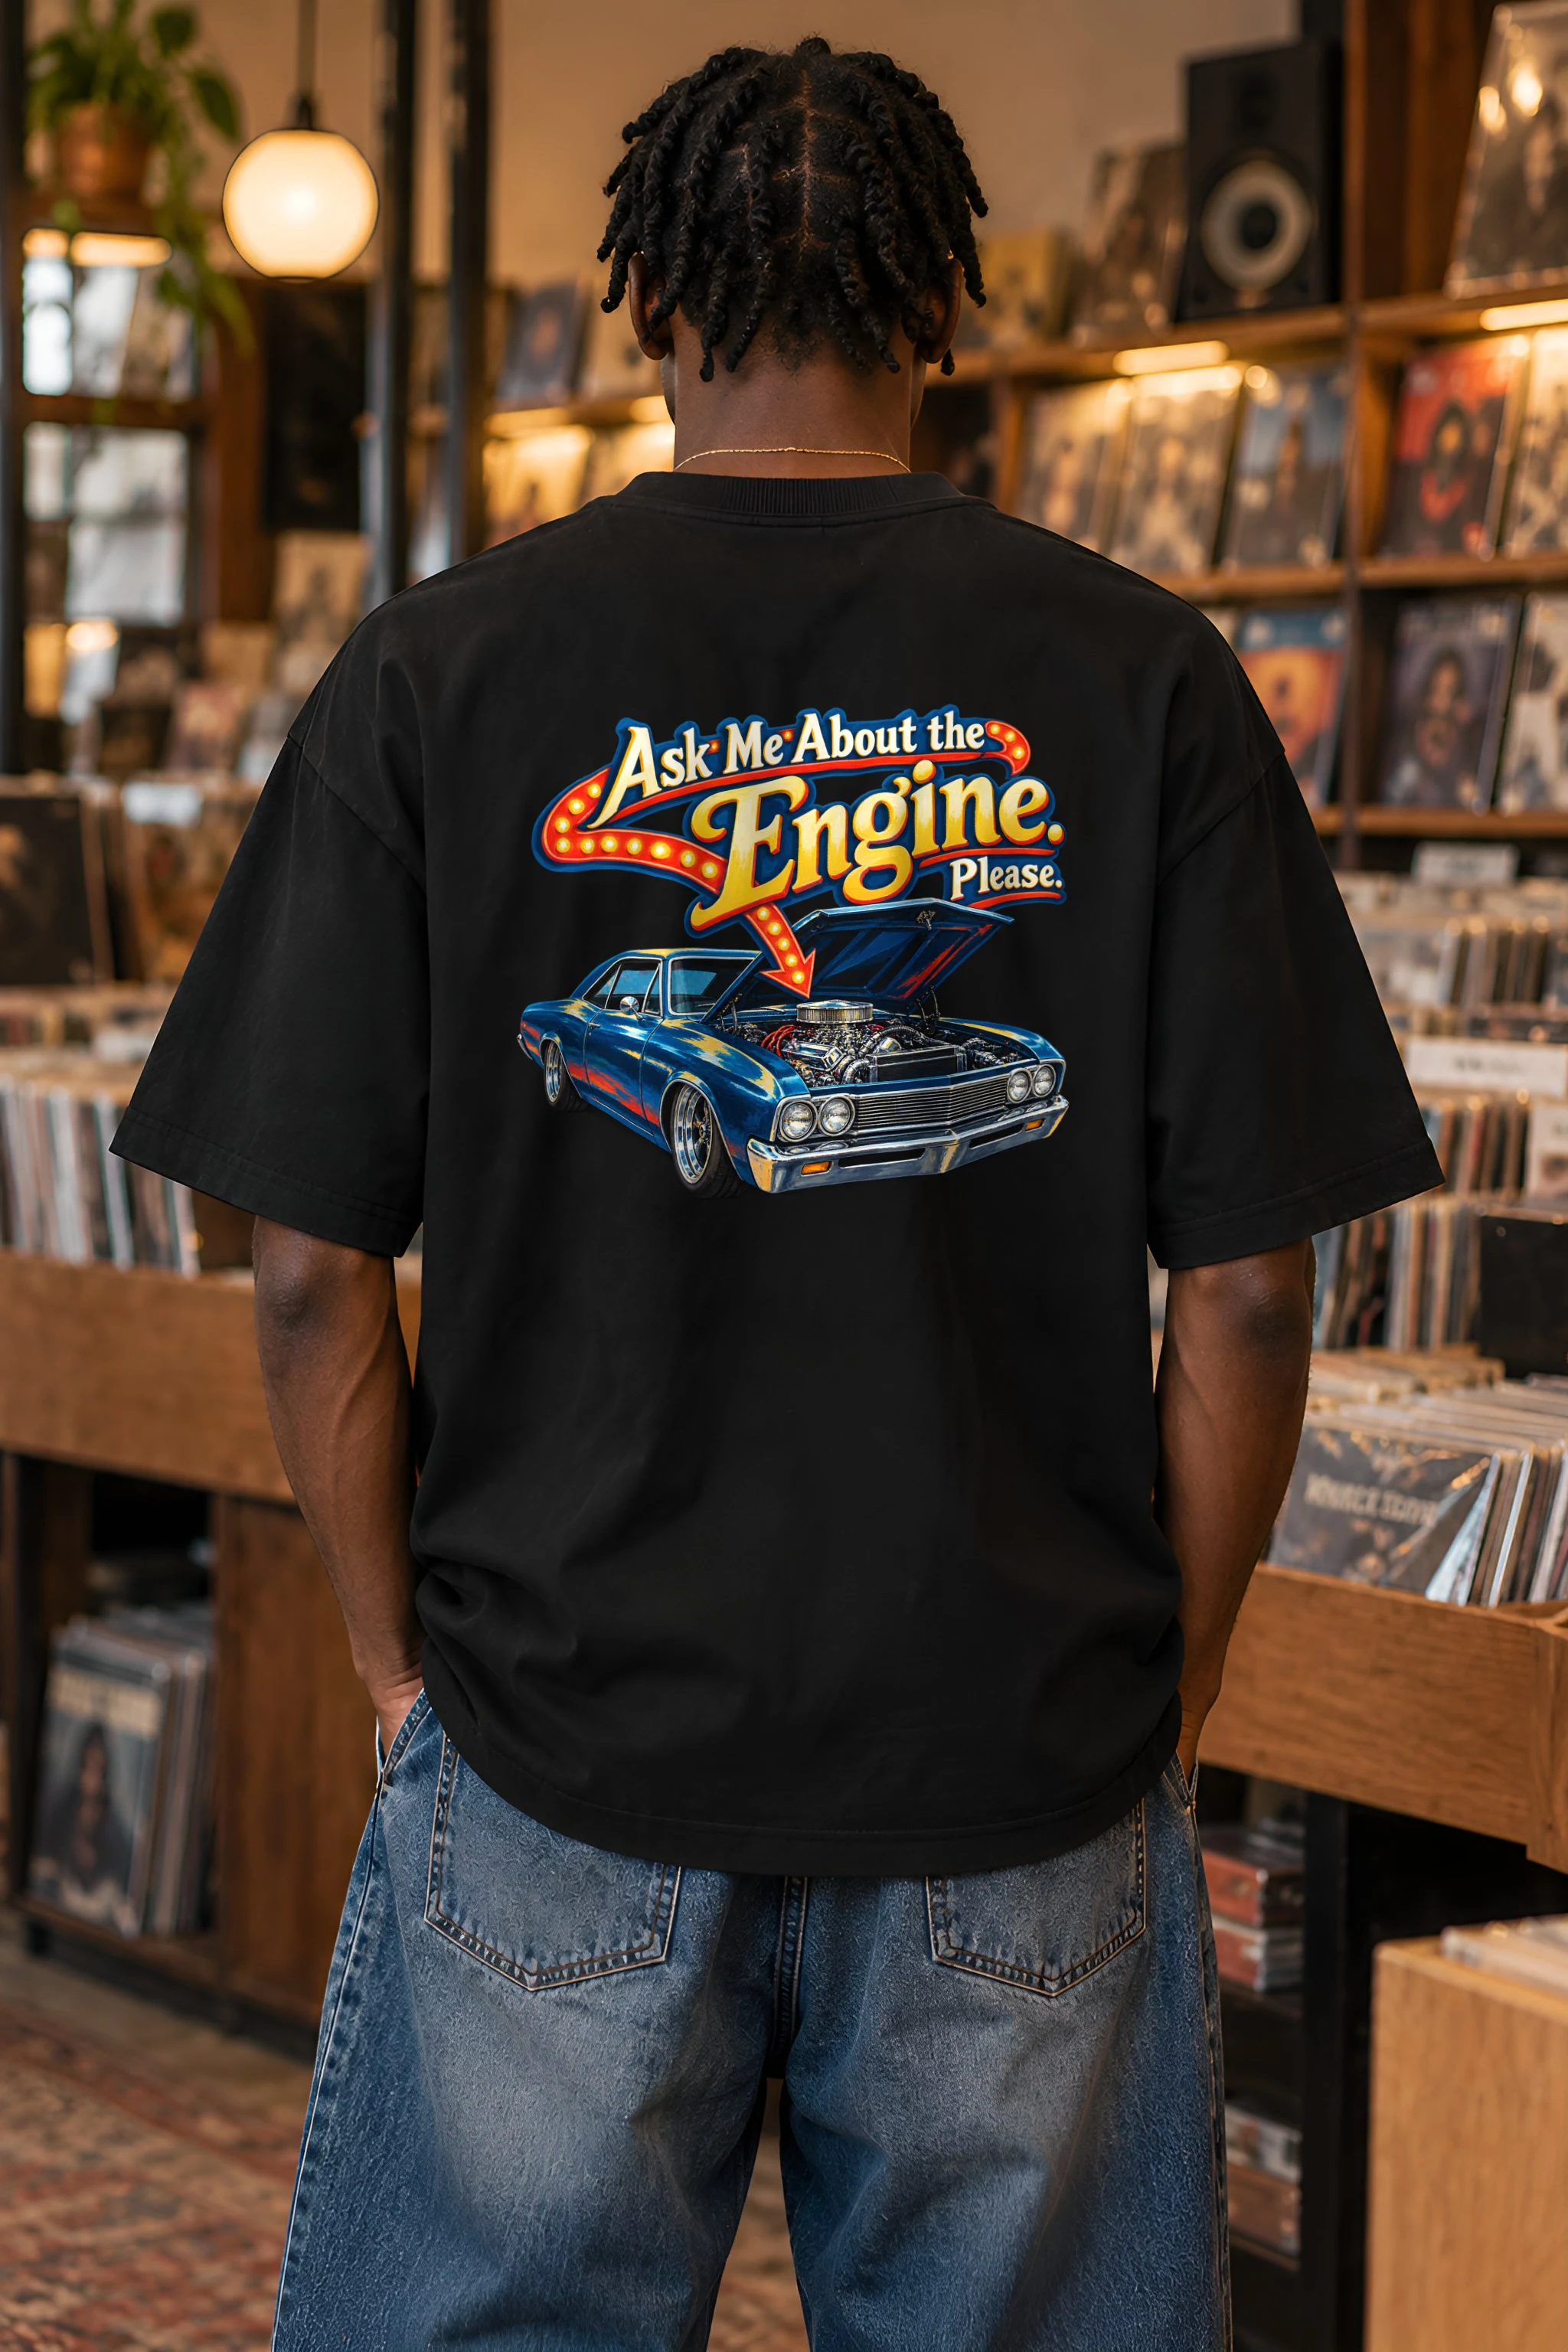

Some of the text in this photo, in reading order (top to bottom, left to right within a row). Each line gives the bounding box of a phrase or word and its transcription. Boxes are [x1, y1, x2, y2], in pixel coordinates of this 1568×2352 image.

[587, 710, 985, 828] Ask Me About the
[691, 760, 1065, 928] Engine.
[950, 857, 1063, 901] Please.
